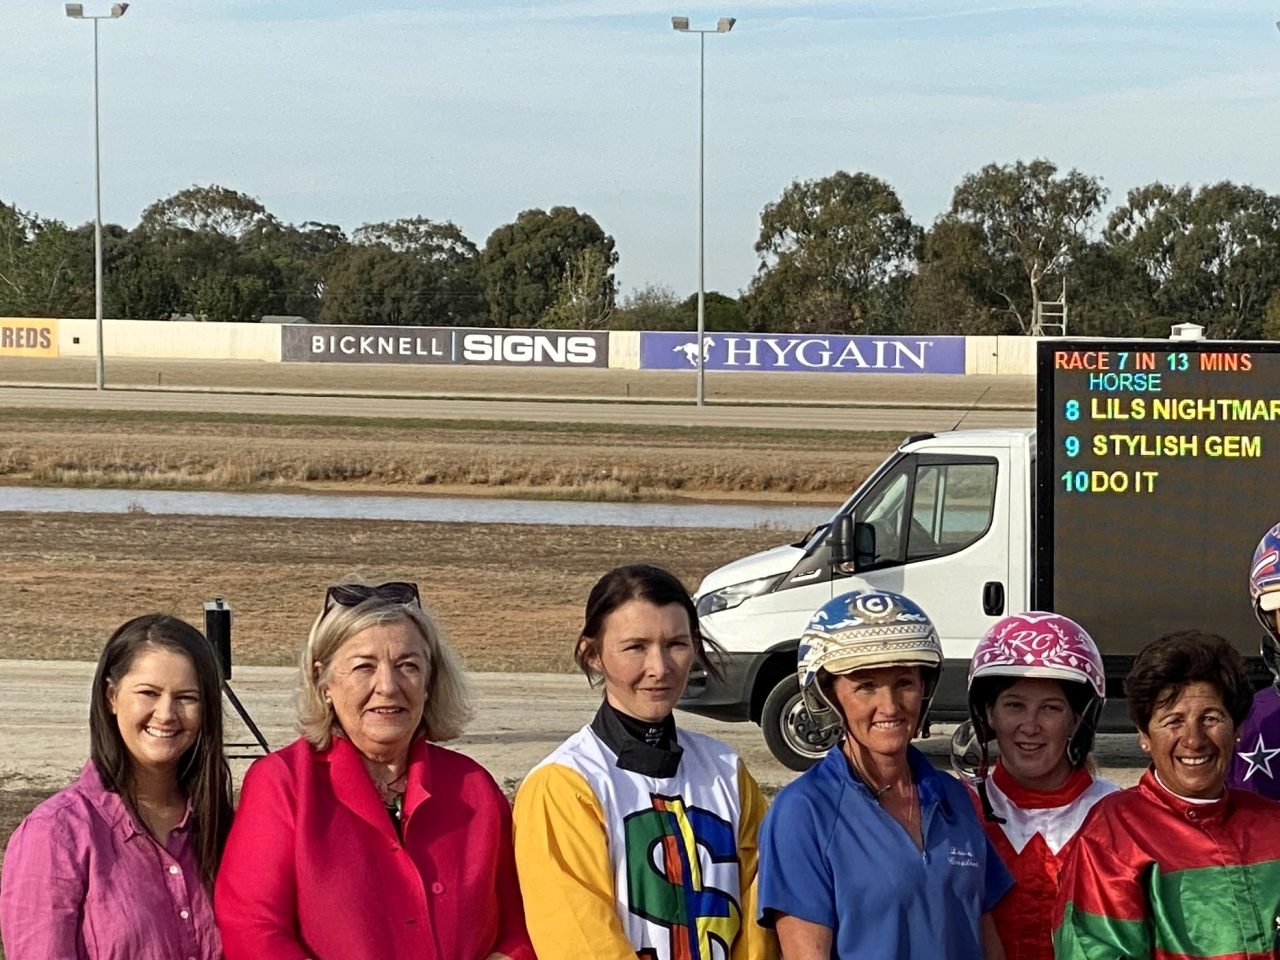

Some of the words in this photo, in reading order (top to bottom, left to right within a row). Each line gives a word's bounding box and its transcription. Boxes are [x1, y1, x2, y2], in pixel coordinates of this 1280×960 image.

[1, 327, 52, 349] REDS
[312, 335, 443, 356] BICKNELL
[463, 334, 597, 363] SIGNS
[723, 338, 930, 369] HYGAIN
[1055, 352, 1110, 370] RACE
[1117, 353, 1130, 370] 7
[1135, 353, 1157, 370] IN
[1167, 353, 1190, 371] 13
[1200, 353, 1253, 371] MINS
[1090, 373, 1162, 391] HORSE
[1065, 400, 1080, 421] 8
[1091, 398, 1146, 420] LILS
[1065, 436, 1080, 457] 9
[1092, 435, 1198, 456] STYLISH
[1205, 436, 1262, 457] GEM
[1061, 471, 1089, 492] 10
[1091, 471, 1129, 492] DO
[1134, 471, 1159, 493] IT
[1008, 630, 1054, 652] RC
